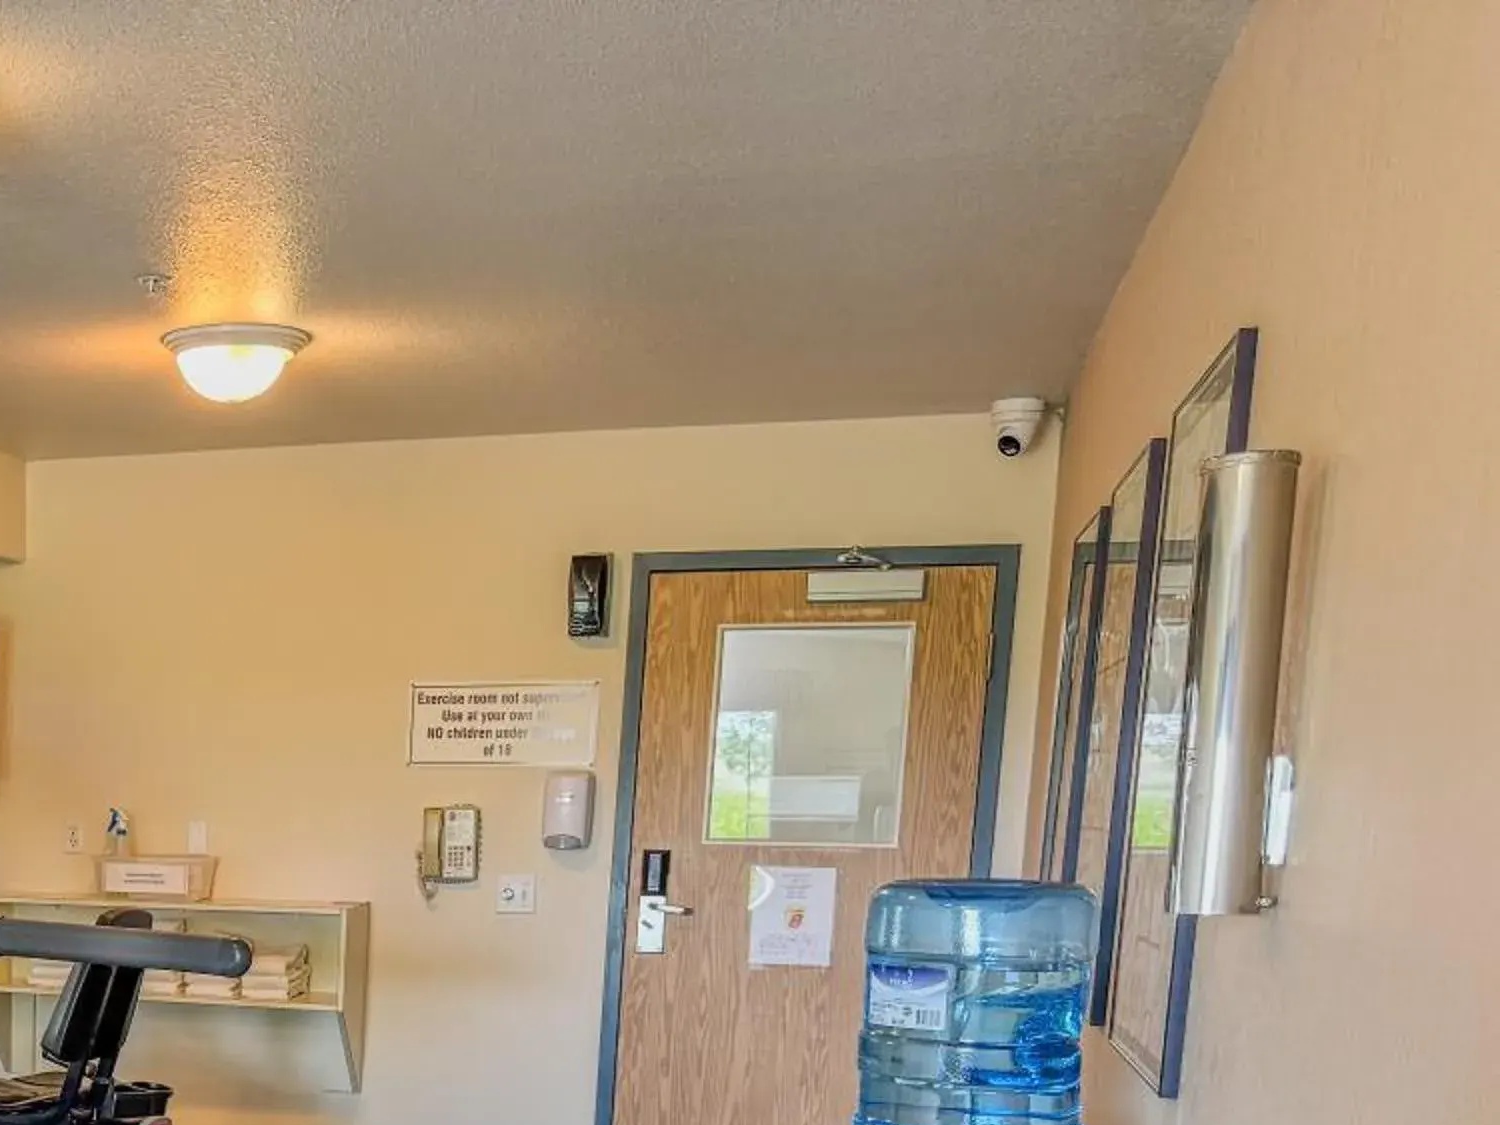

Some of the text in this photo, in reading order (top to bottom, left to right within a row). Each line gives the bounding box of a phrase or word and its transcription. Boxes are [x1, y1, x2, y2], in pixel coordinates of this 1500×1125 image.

[417, 692, 465, 705] Exercise
[467, 693, 497, 705] room
[501, 691, 520, 705] not
[441, 709, 463, 721] Use
[481, 711, 506, 724] your
[509, 711, 533, 721] own
[426, 727, 529, 740] NO children under
